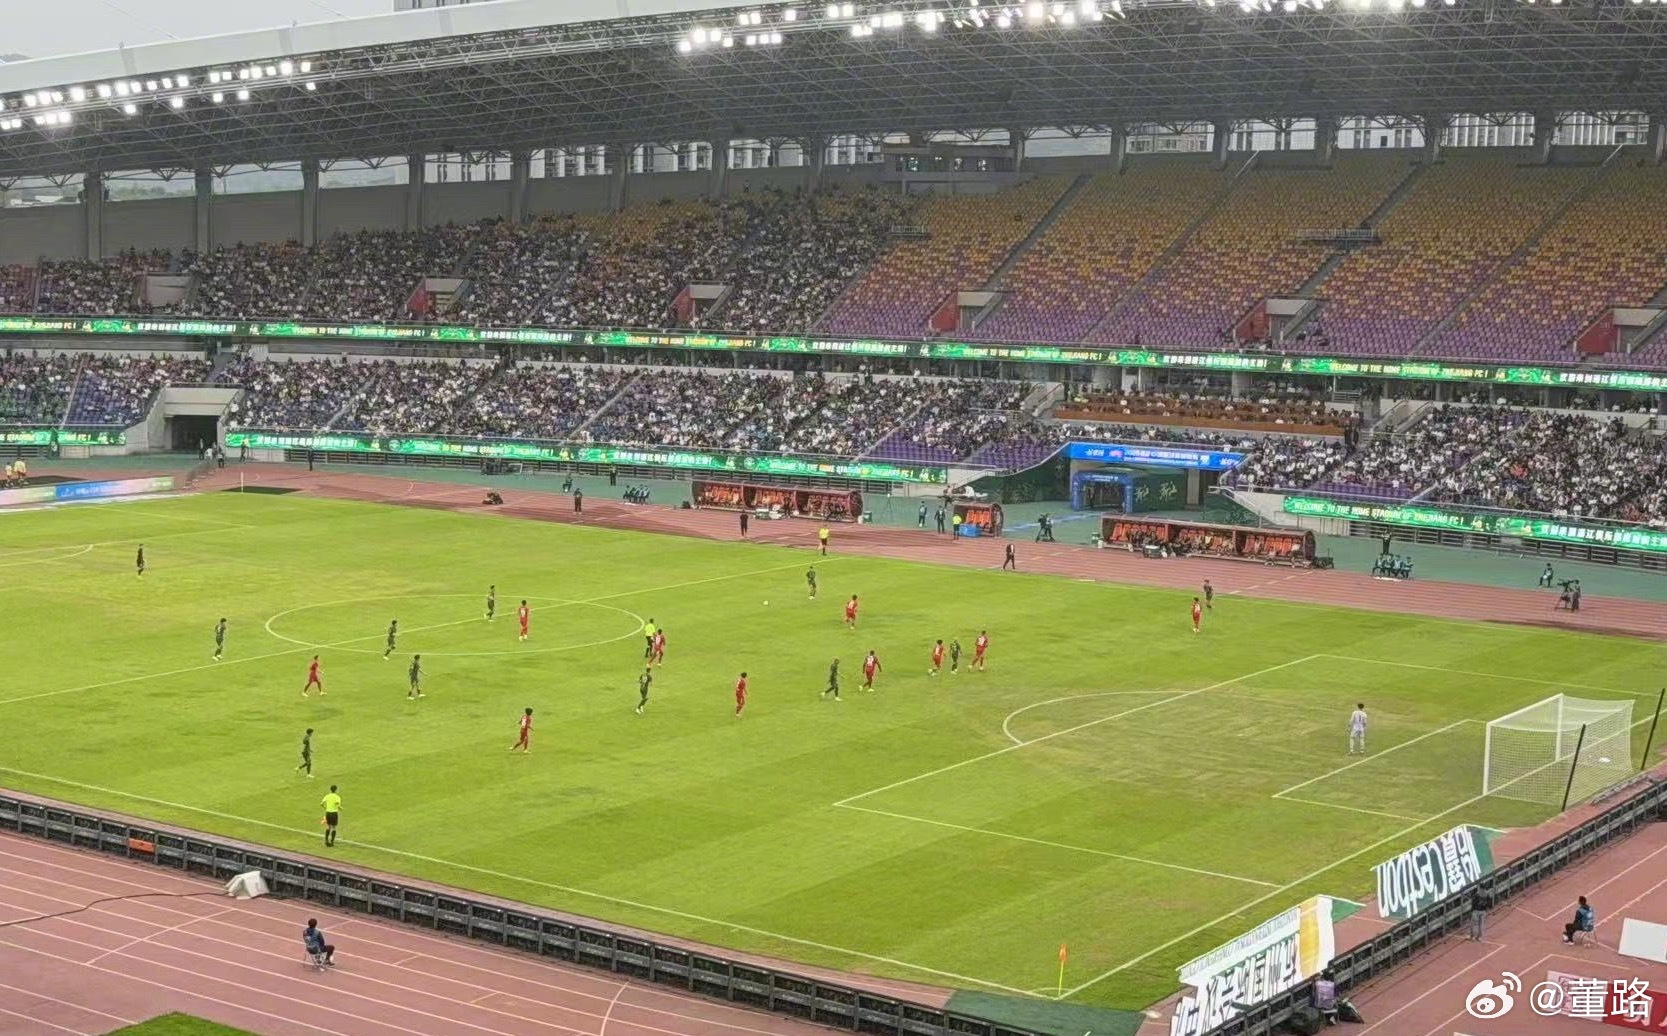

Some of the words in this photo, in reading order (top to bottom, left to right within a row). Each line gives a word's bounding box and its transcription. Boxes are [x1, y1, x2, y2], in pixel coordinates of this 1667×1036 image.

[1327, 504, 1336, 514] TO
[1337, 505, 1350, 515] THE
[1449, 514, 1459, 524] FC
